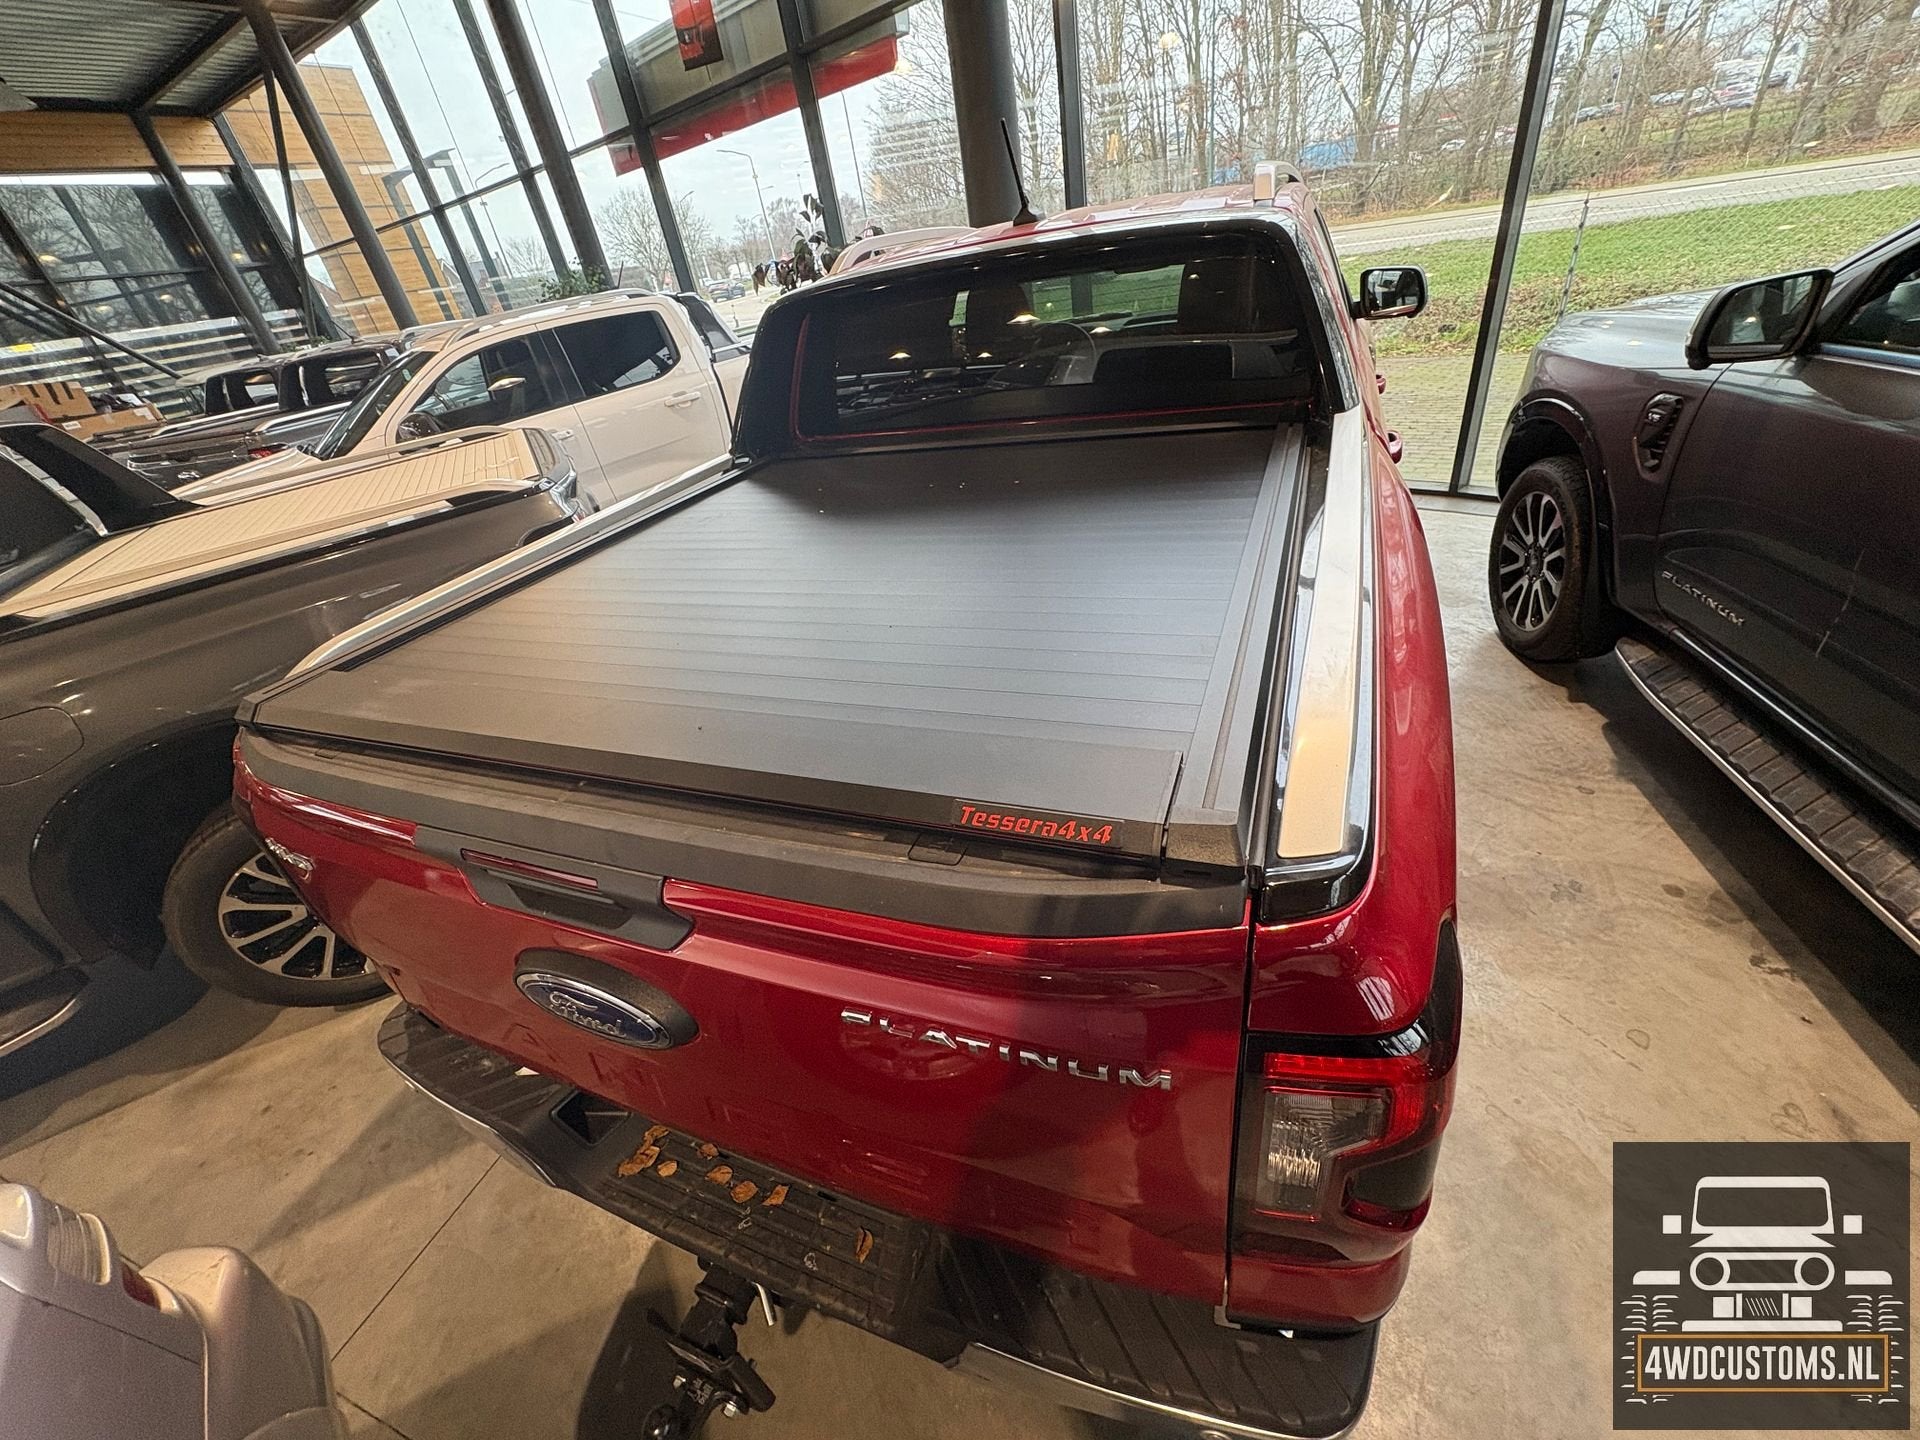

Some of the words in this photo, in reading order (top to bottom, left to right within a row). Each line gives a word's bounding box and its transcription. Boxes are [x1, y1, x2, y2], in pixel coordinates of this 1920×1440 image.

[1661, 570, 1745, 626] PLATINUM
[960, 805, 1113, 844] Tessera4x4
[550, 991, 627, 1037] Ford
[841, 1007, 1172, 1090] PLATINUM
